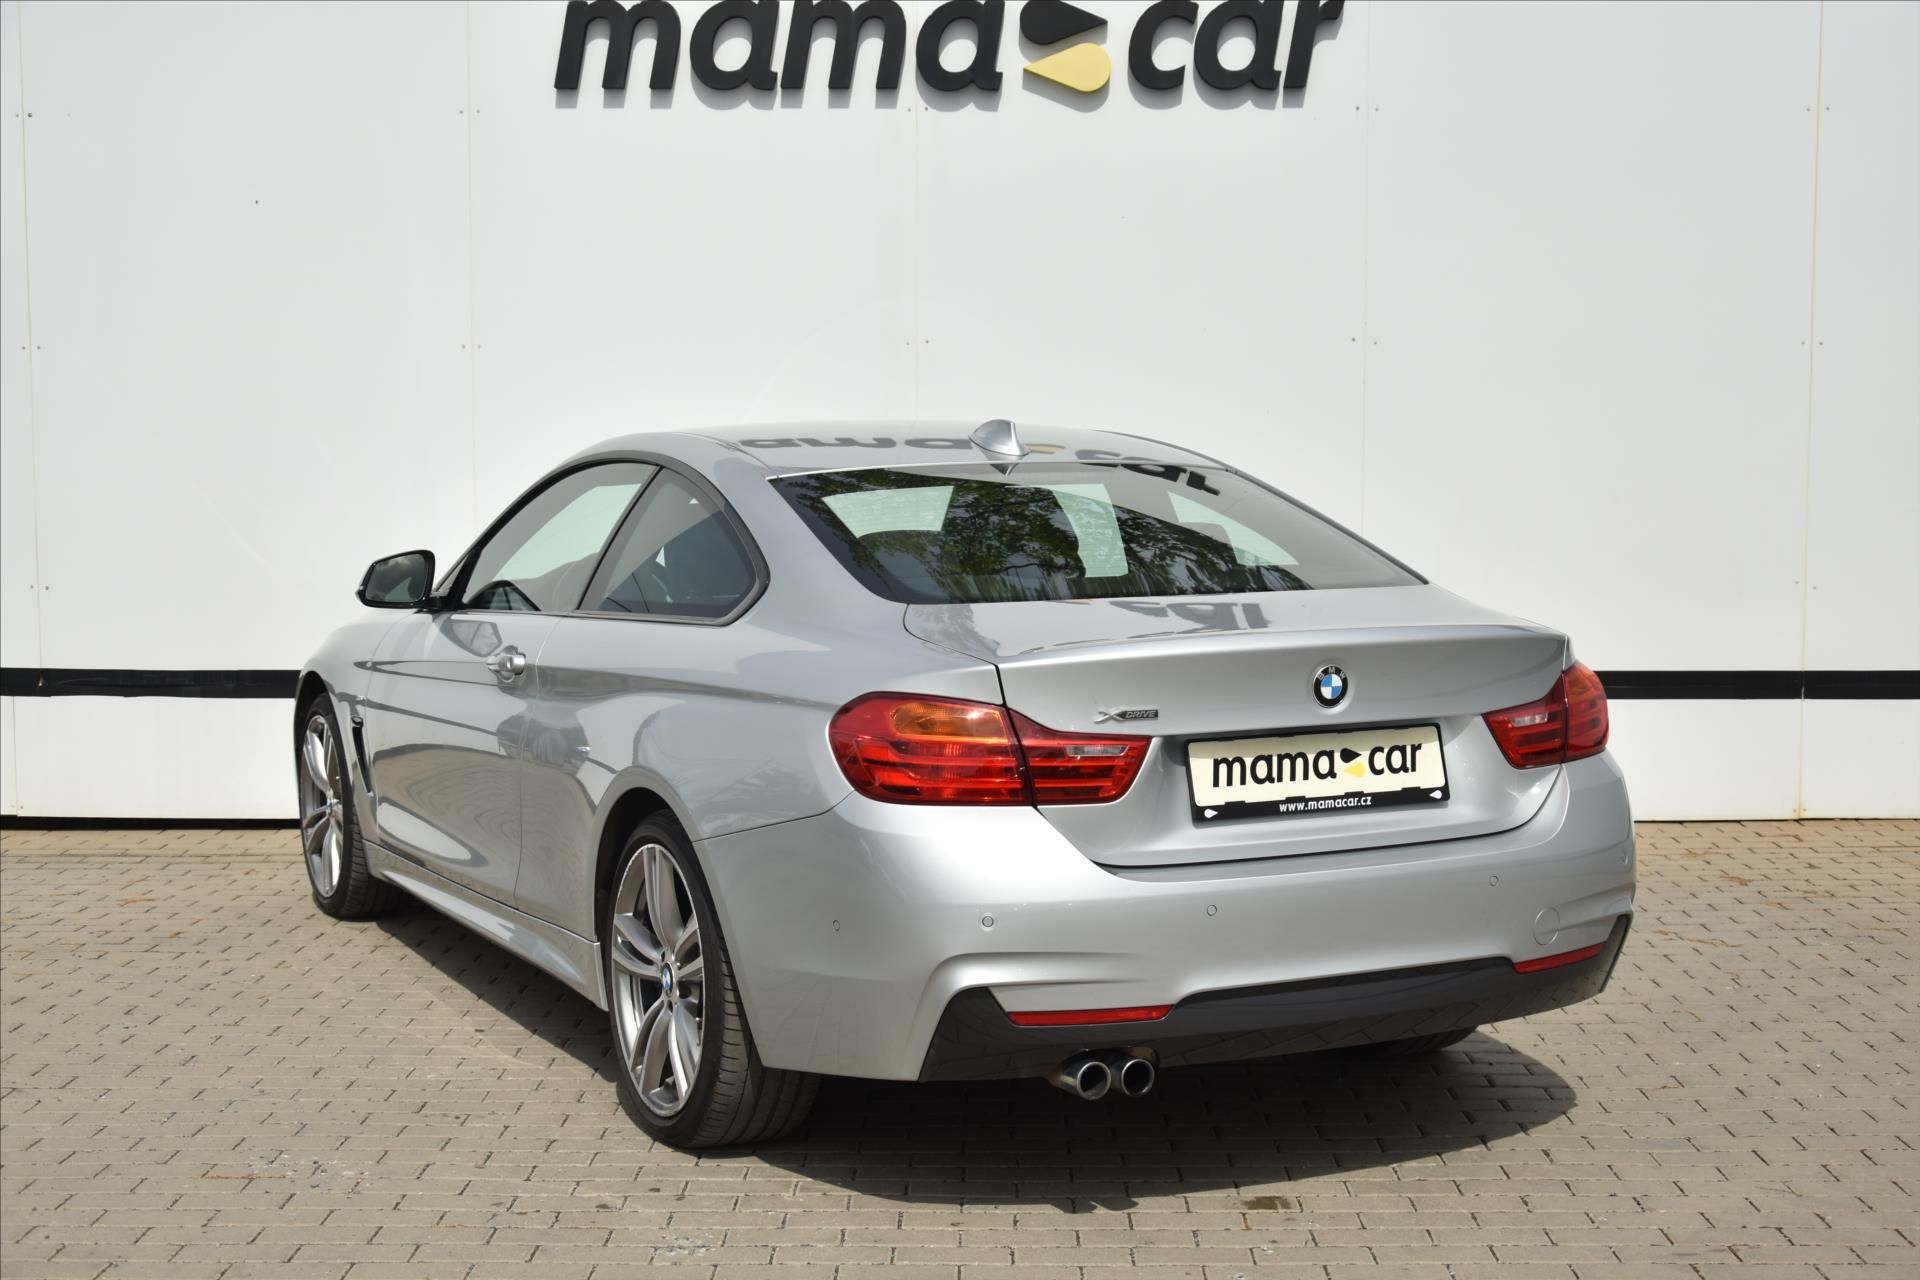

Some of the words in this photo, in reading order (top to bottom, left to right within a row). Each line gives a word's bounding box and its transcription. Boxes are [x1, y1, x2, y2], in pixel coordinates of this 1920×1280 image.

[554, 0, 1003, 91] mama
[1128, 0, 1345, 90] car
[1212, 749, 1337, 788] mama
[1368, 743, 1422, 776] car
[1279, 796, 1372, 813] www.mamacar.cz
